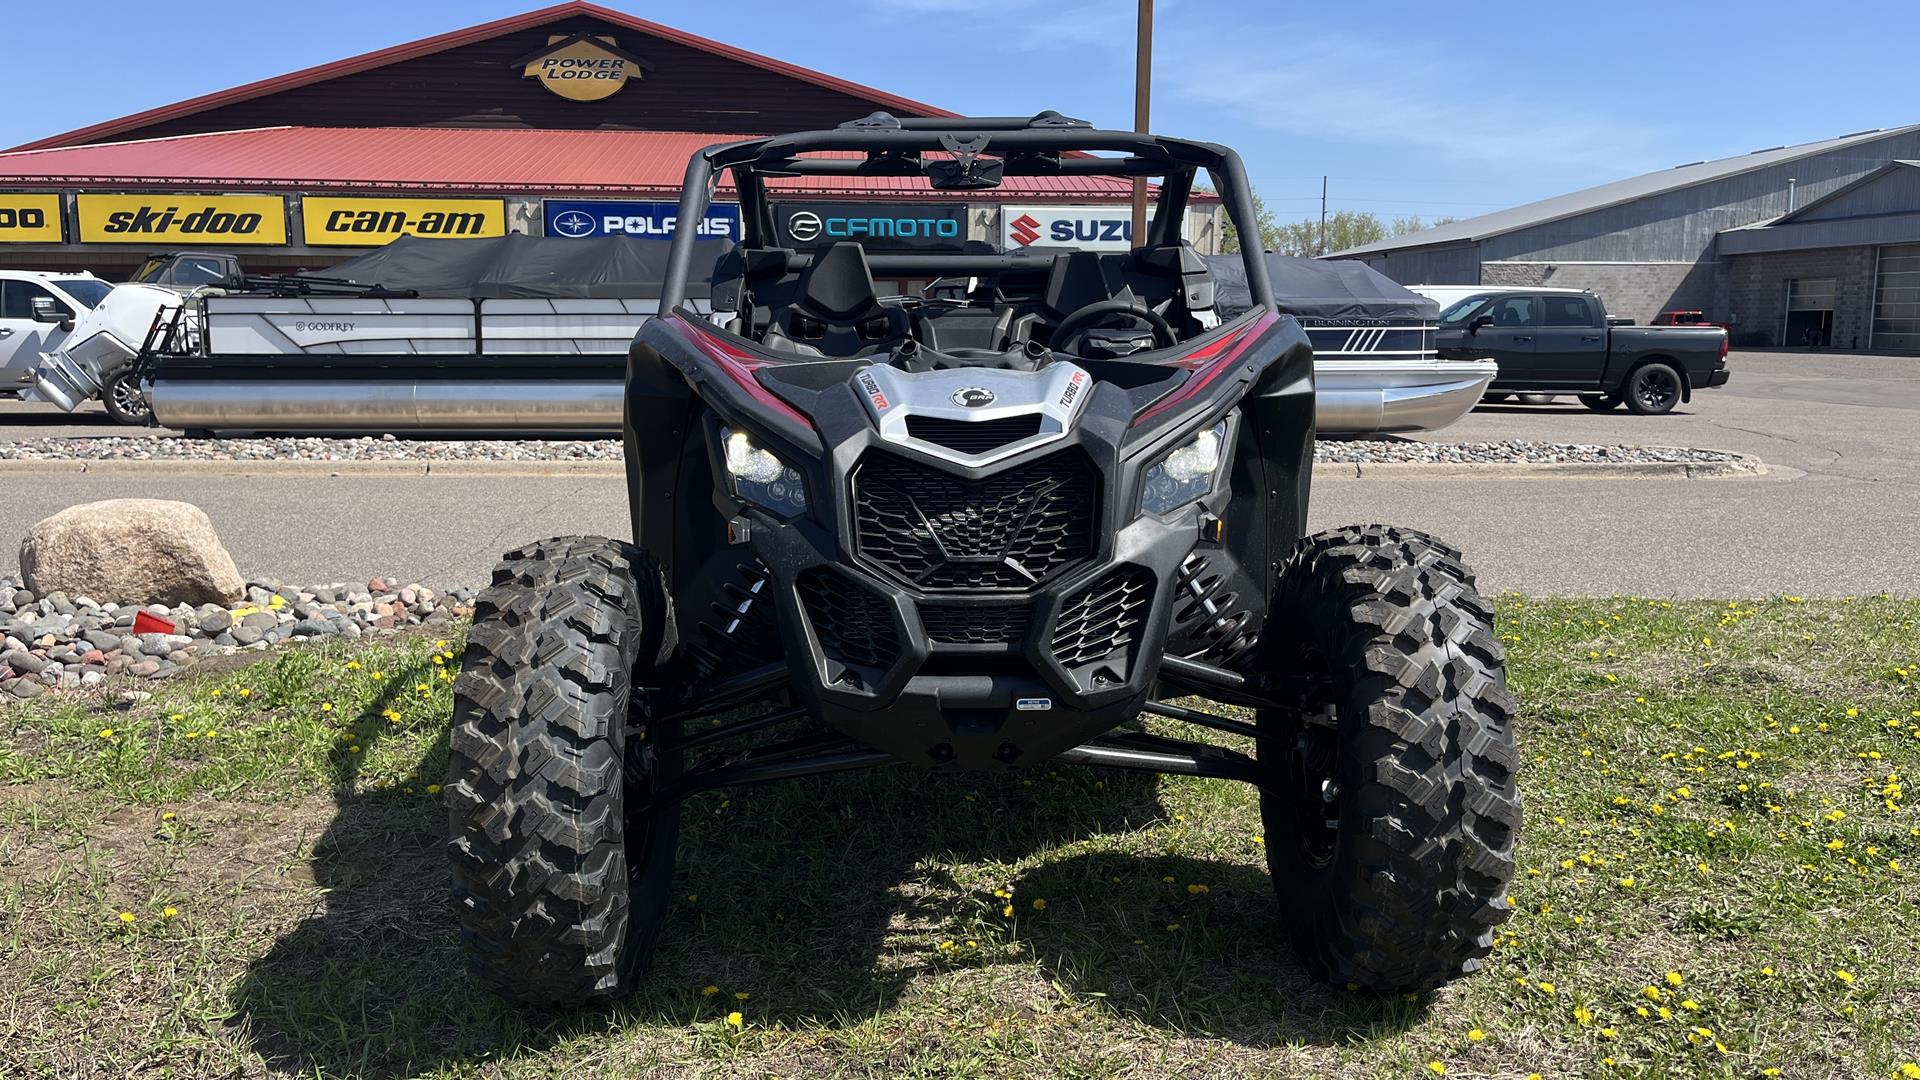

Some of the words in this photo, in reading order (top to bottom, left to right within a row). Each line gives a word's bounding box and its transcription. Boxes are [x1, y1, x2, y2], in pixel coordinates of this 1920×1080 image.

[542, 58, 624, 69] POWER
[546, 69, 623, 80] LODGE
[104, 207, 262, 233] ski-doo
[325, 210, 485, 234] can-am
[825, 218, 958, 237] CFMOTO
[308, 322, 355, 332] GODFREY
[860, 373, 880, 395] TURBO
[871, 393, 888, 410] RR
[969, 392, 993, 400] BRP
[1059, 381, 1080, 409] TURBO
[1071, 371, 1086, 386] RR
